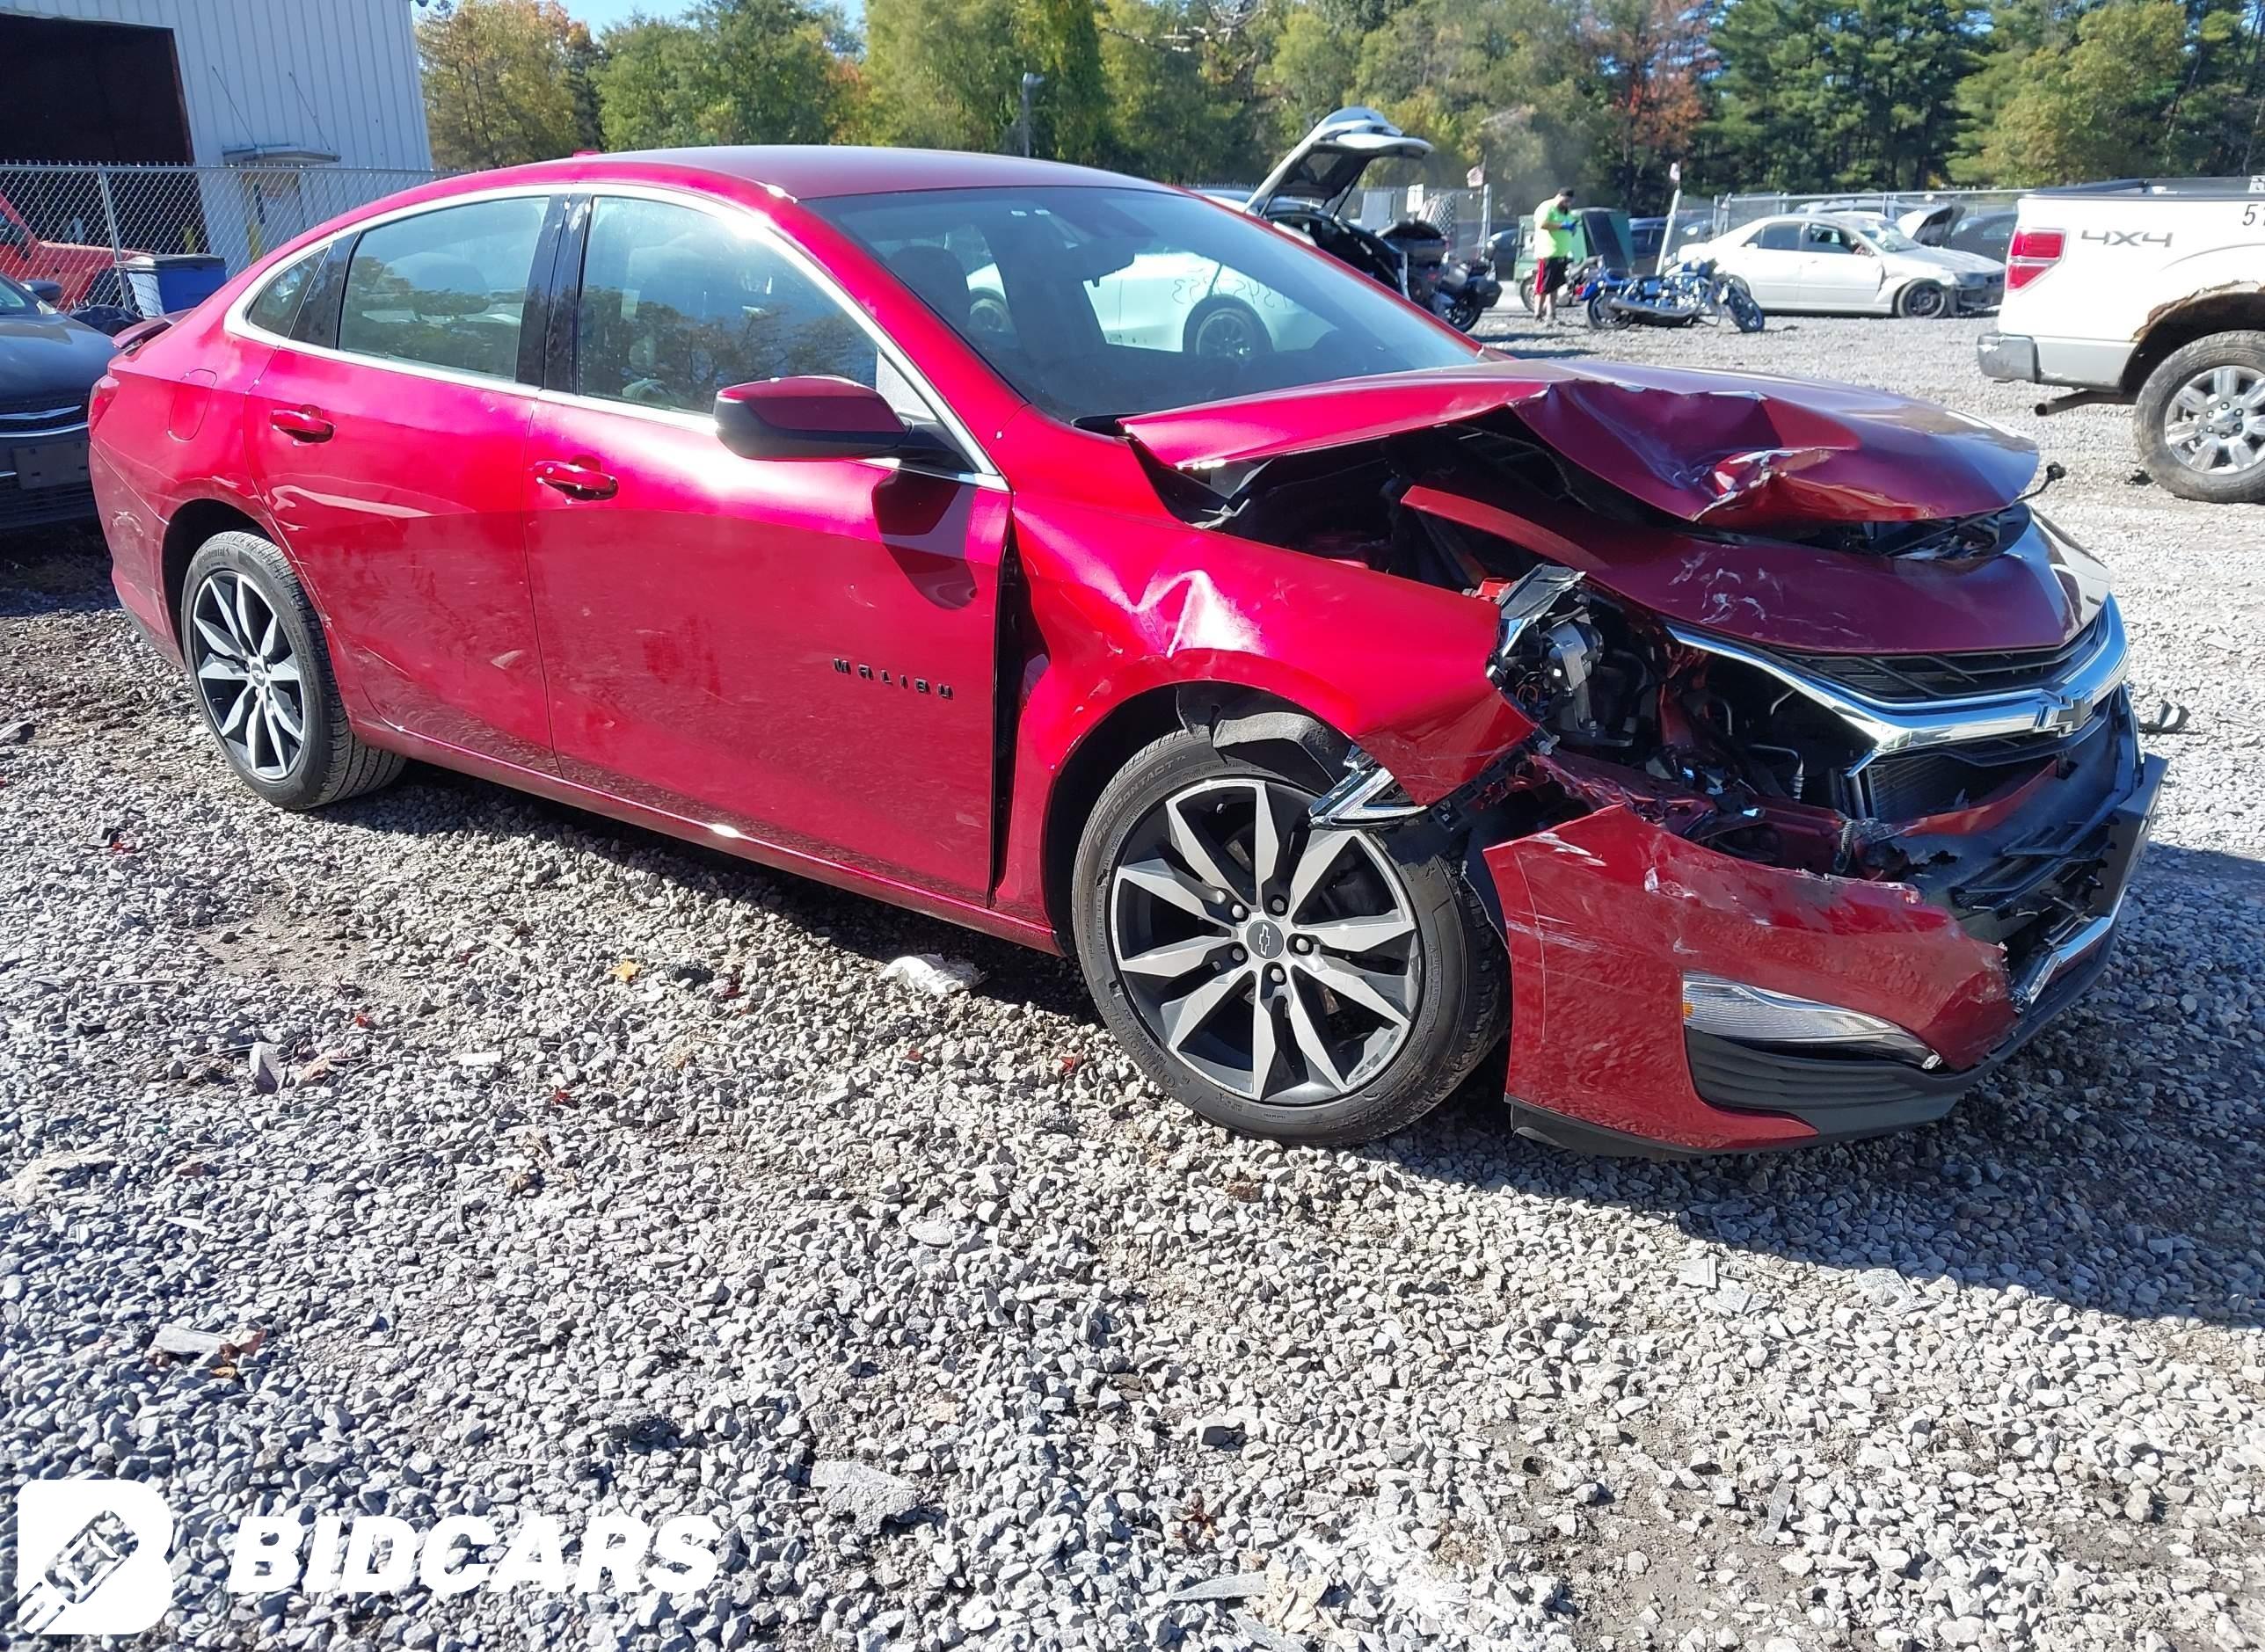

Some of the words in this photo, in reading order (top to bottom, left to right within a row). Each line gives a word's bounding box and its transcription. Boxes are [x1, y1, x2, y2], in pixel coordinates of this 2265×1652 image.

[2242, 203, 2265, 226] 5
[2080, 229, 2174, 248] 4X4
[833, 658, 954, 700] MALIBU
